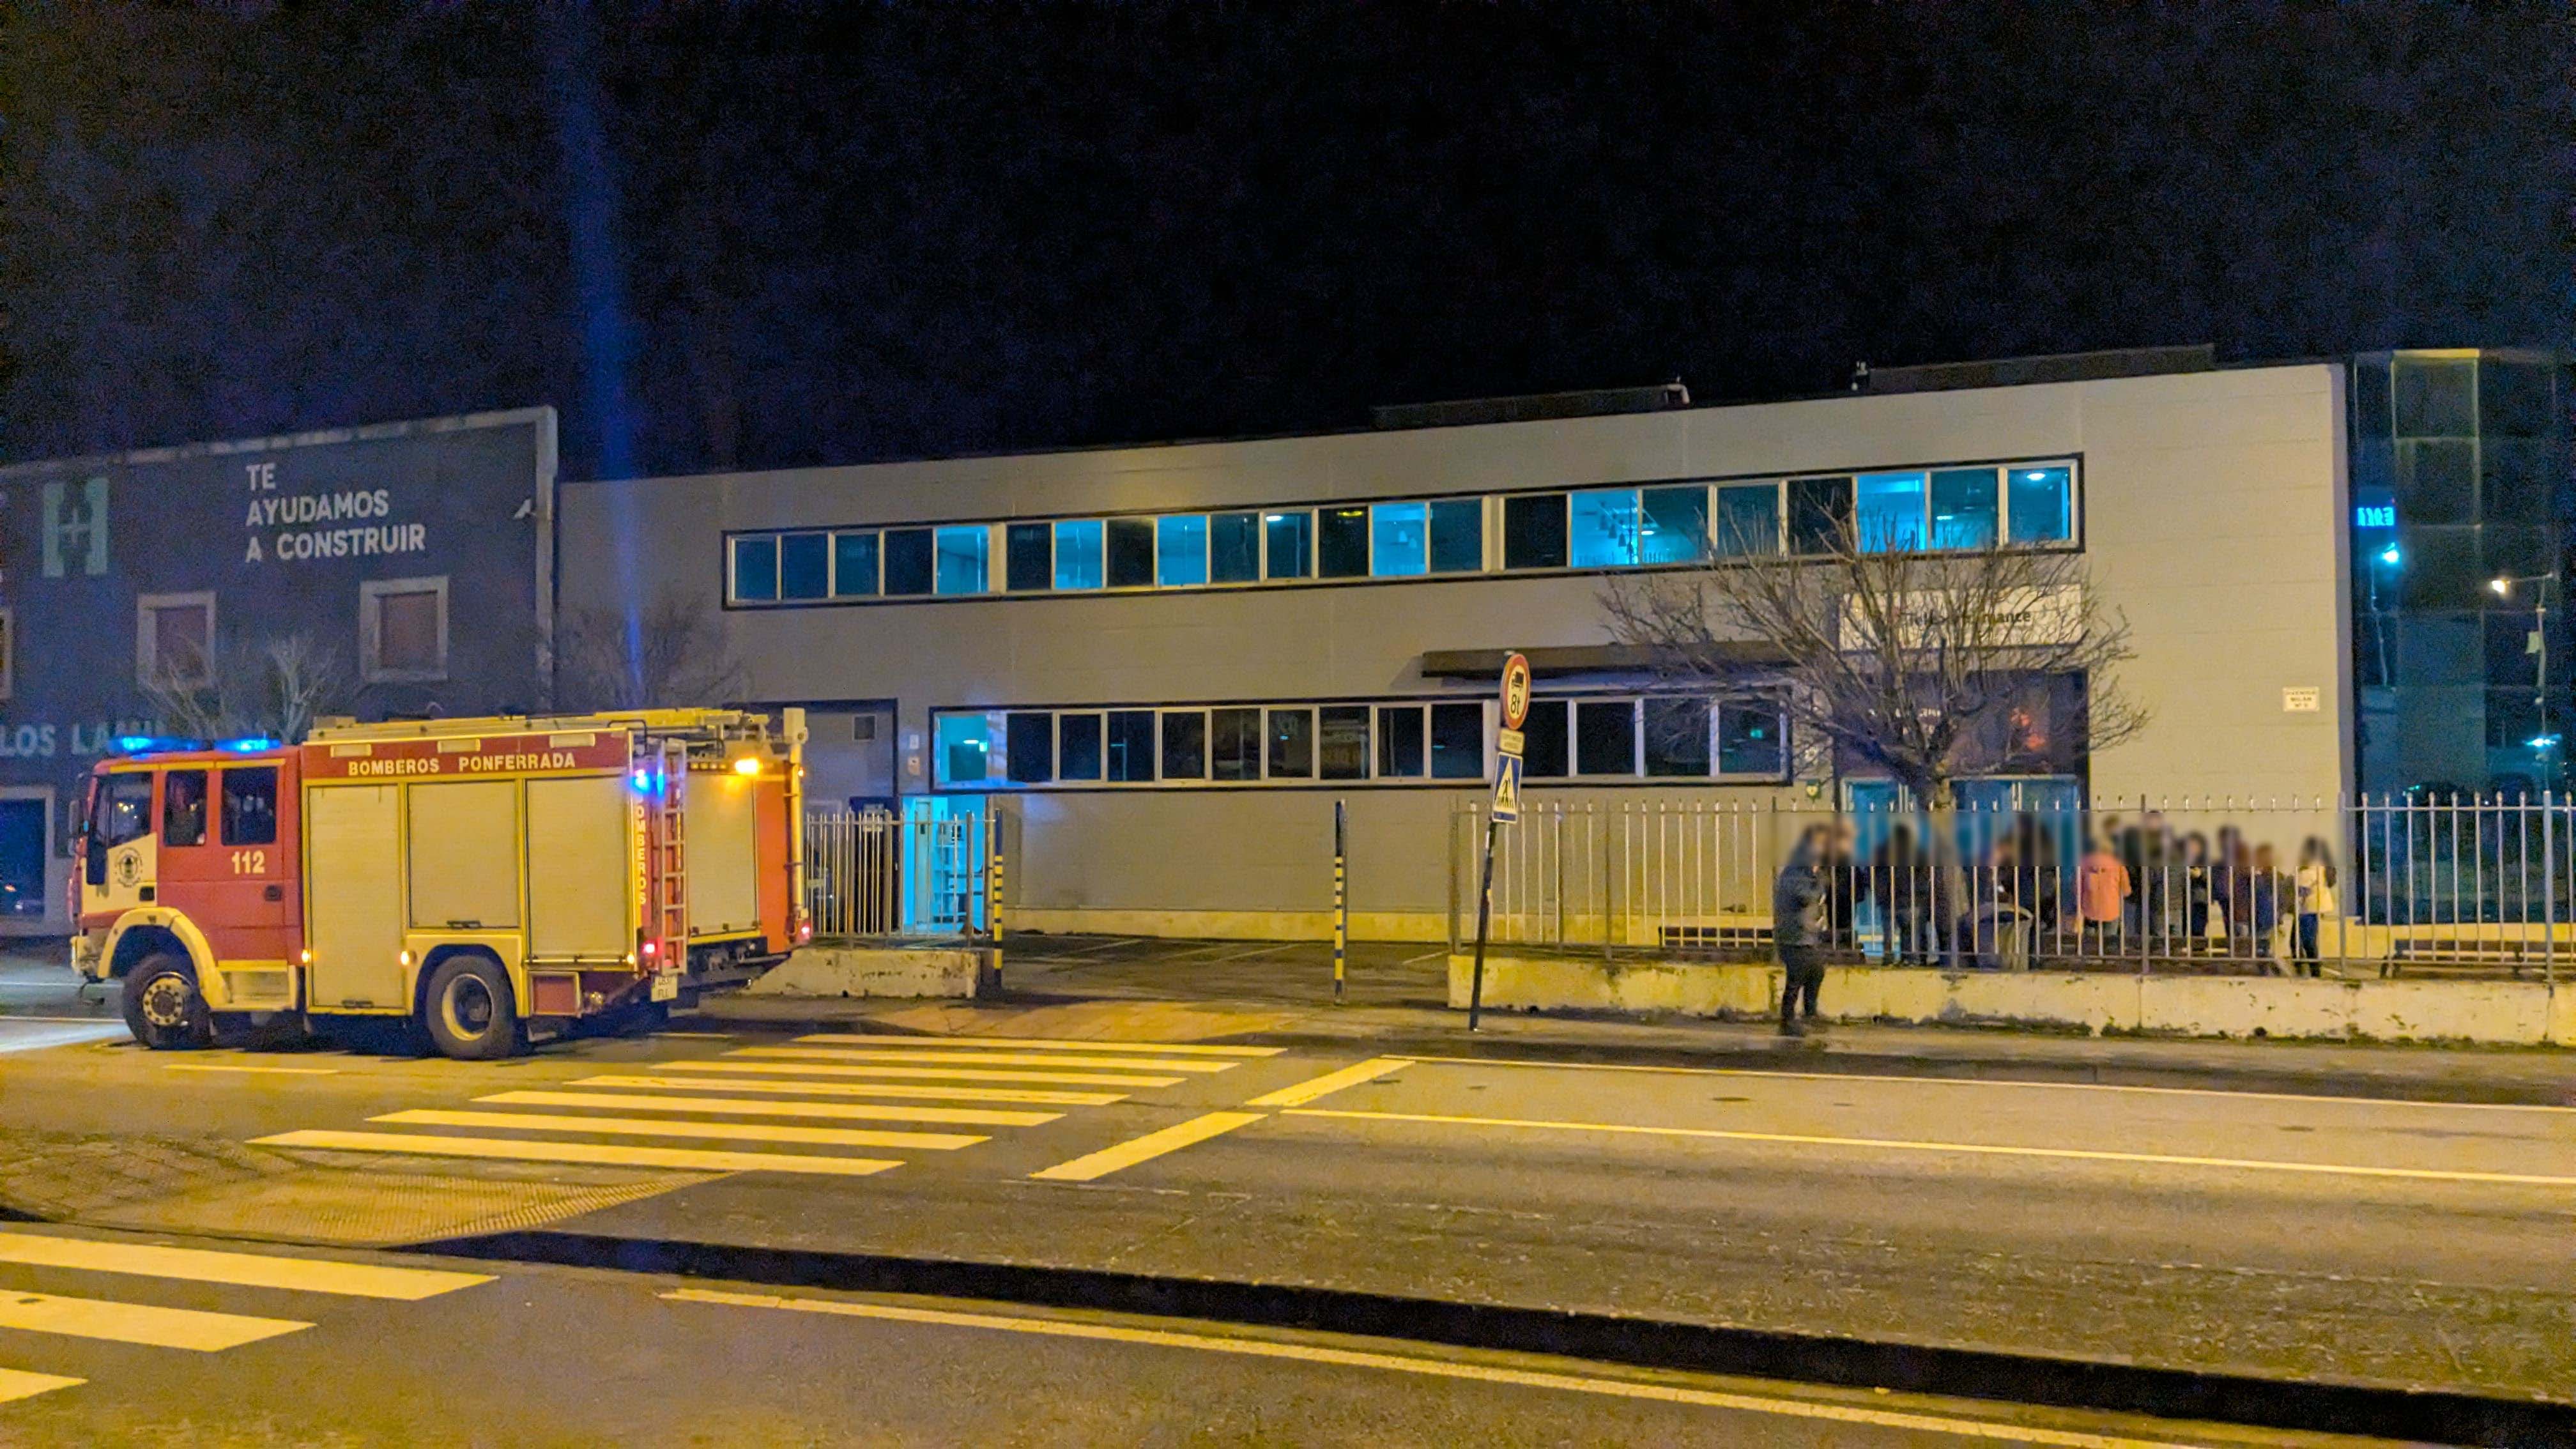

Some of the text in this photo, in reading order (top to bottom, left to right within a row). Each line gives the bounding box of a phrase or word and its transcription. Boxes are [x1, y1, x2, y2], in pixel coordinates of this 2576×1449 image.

[246, 463, 276, 491] TE
[245, 489, 389, 526] AYUDAMOS
[245, 523, 426, 563] A CONSTRUIR
[348, 753, 576, 776] BOMBEROS PONFERRADA
[231, 850, 265, 874] 112
